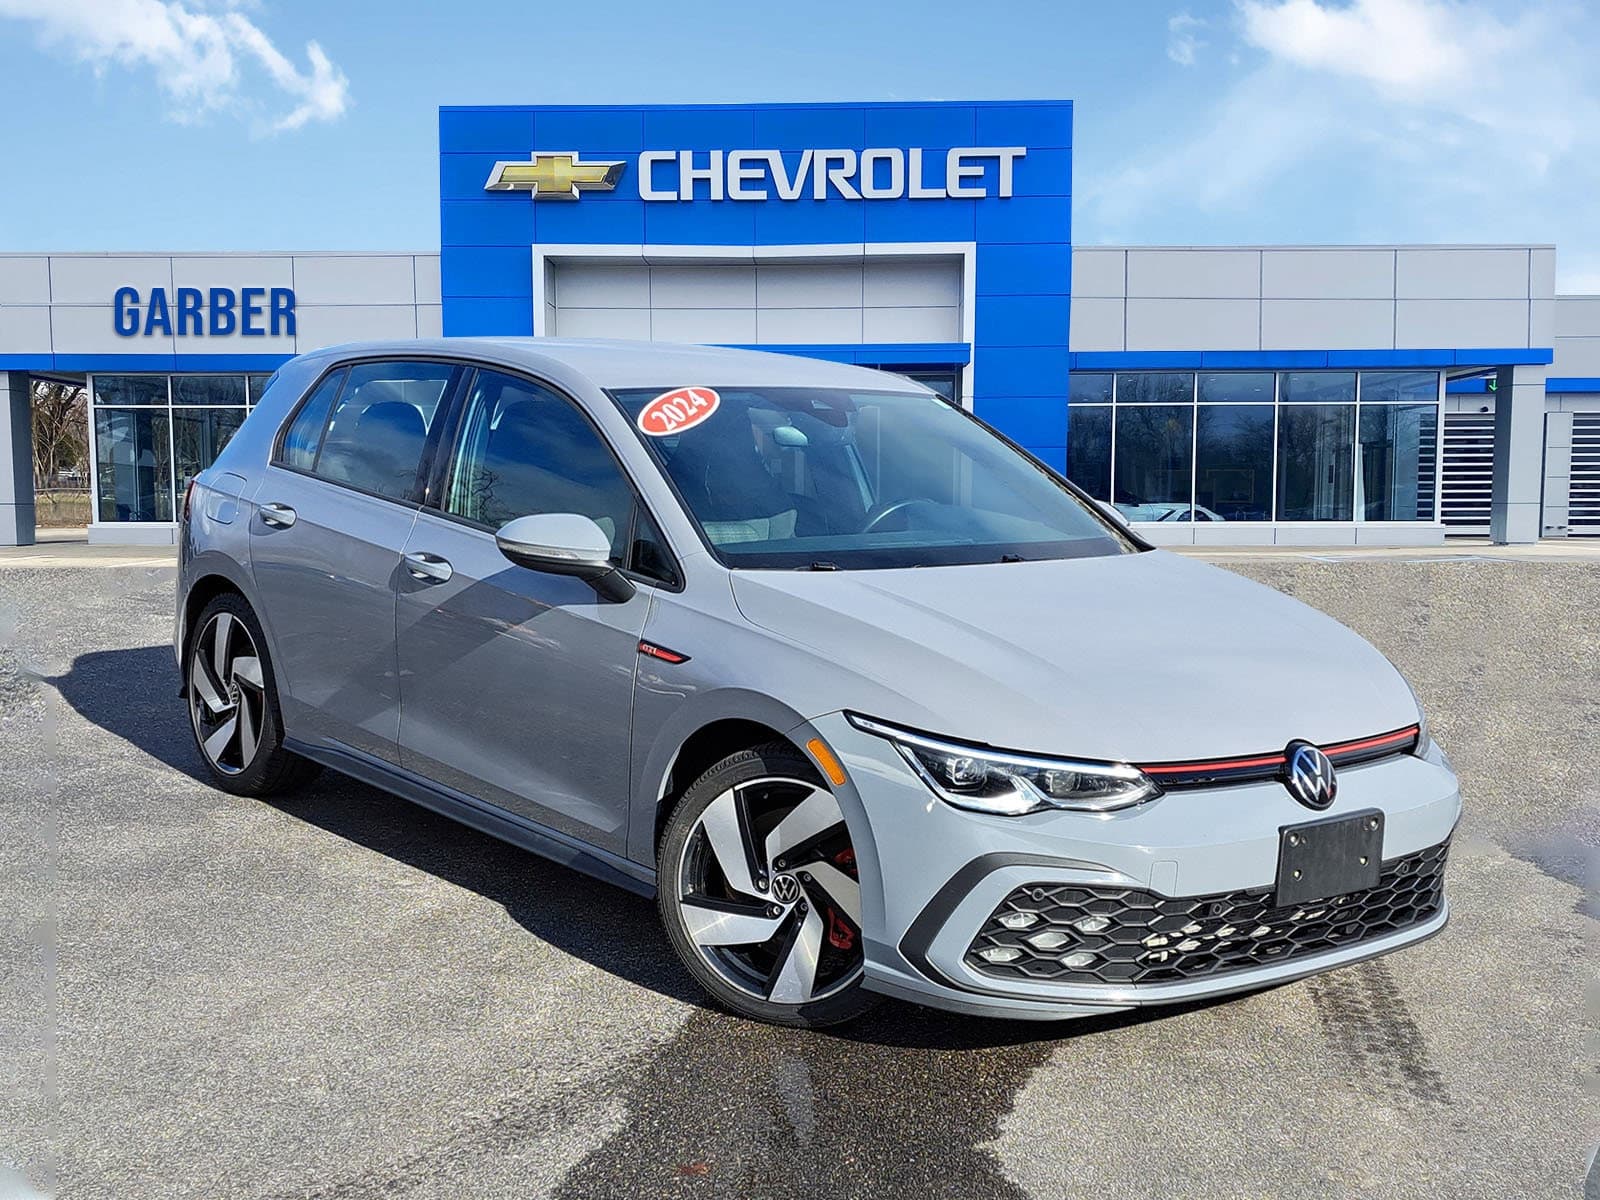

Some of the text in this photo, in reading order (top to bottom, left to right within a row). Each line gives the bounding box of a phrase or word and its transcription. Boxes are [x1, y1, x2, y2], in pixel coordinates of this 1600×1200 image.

[638, 147, 1027, 201] CHEVROLET
[114, 286, 296, 336] GARBER
[652, 389, 708, 431] 2024
[1293, 746, 1336, 806] VW
[773, 875, 799, 903] VW
